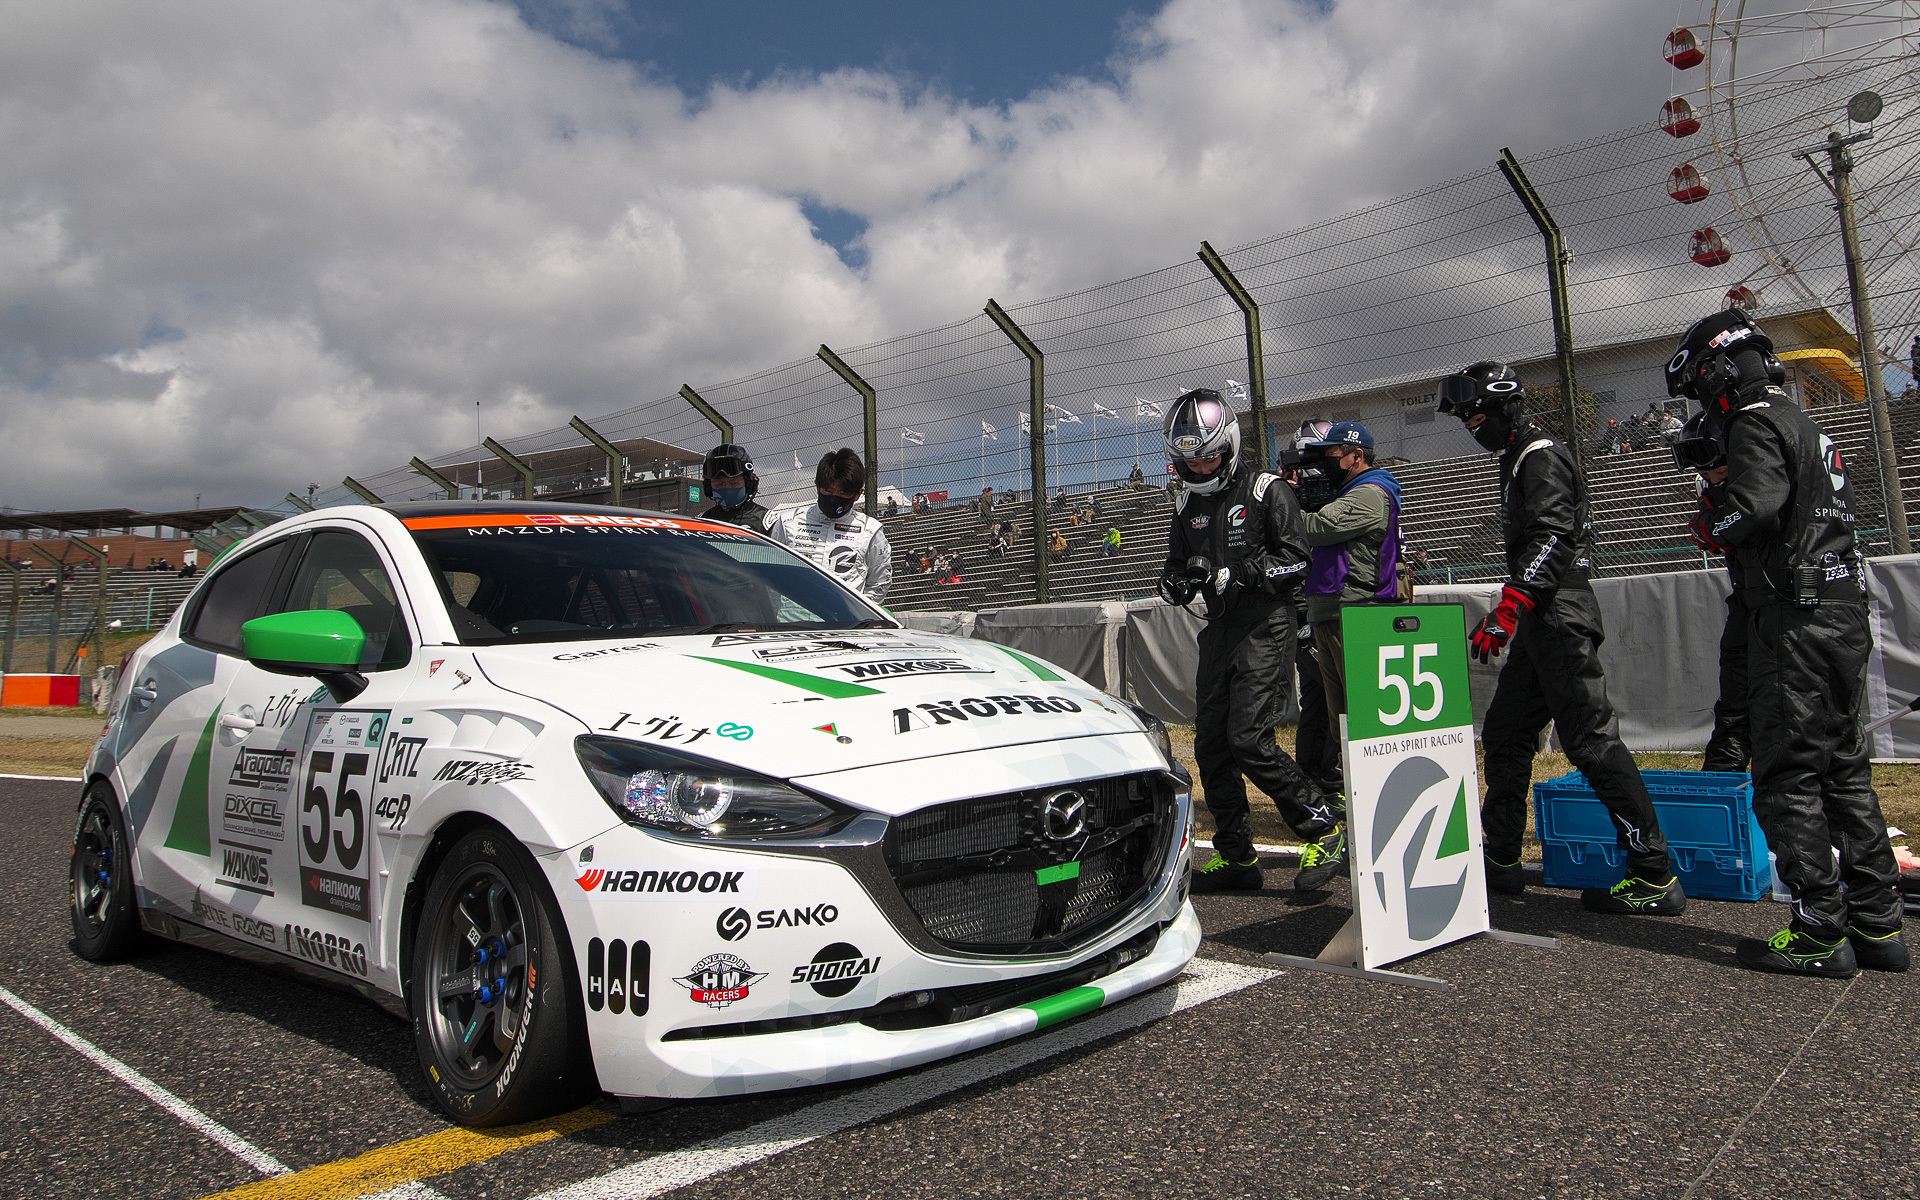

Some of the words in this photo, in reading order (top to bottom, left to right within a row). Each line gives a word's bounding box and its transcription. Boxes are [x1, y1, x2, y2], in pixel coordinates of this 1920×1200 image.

[1400, 393, 1437, 408] TOILET
[1347, 430, 1360, 441] 19
[467, 526, 576, 537] MAZDA
[584, 526, 659, 536] SPIRIT
[667, 528, 750, 542] RACING
[557, 515, 682, 529] ENEOS
[553, 642, 665, 661] Garrett
[1377, 642, 1445, 727] 55
[368, 717, 384, 743] Q
[598, 711, 711, 744] ユーグレナ
[1363, 742, 1398, 758] MAZDA
[1400, 737, 1429, 753] SPIRIT
[1431, 732, 1464, 749] RACING
[229, 745, 297, 780] Aragosta
[225, 796, 283, 824] DIXCEL
[302, 750, 370, 871] 55
[375, 793, 411, 831] 4CR
[756, 903, 839, 929] SANKO
[691, 952, 738, 974] POWERED
[736, 958, 751, 972] BY
[790, 956, 881, 984] SHORAI
[589, 975, 647, 999] HAL
[702, 989, 740, 1001] RACERS
